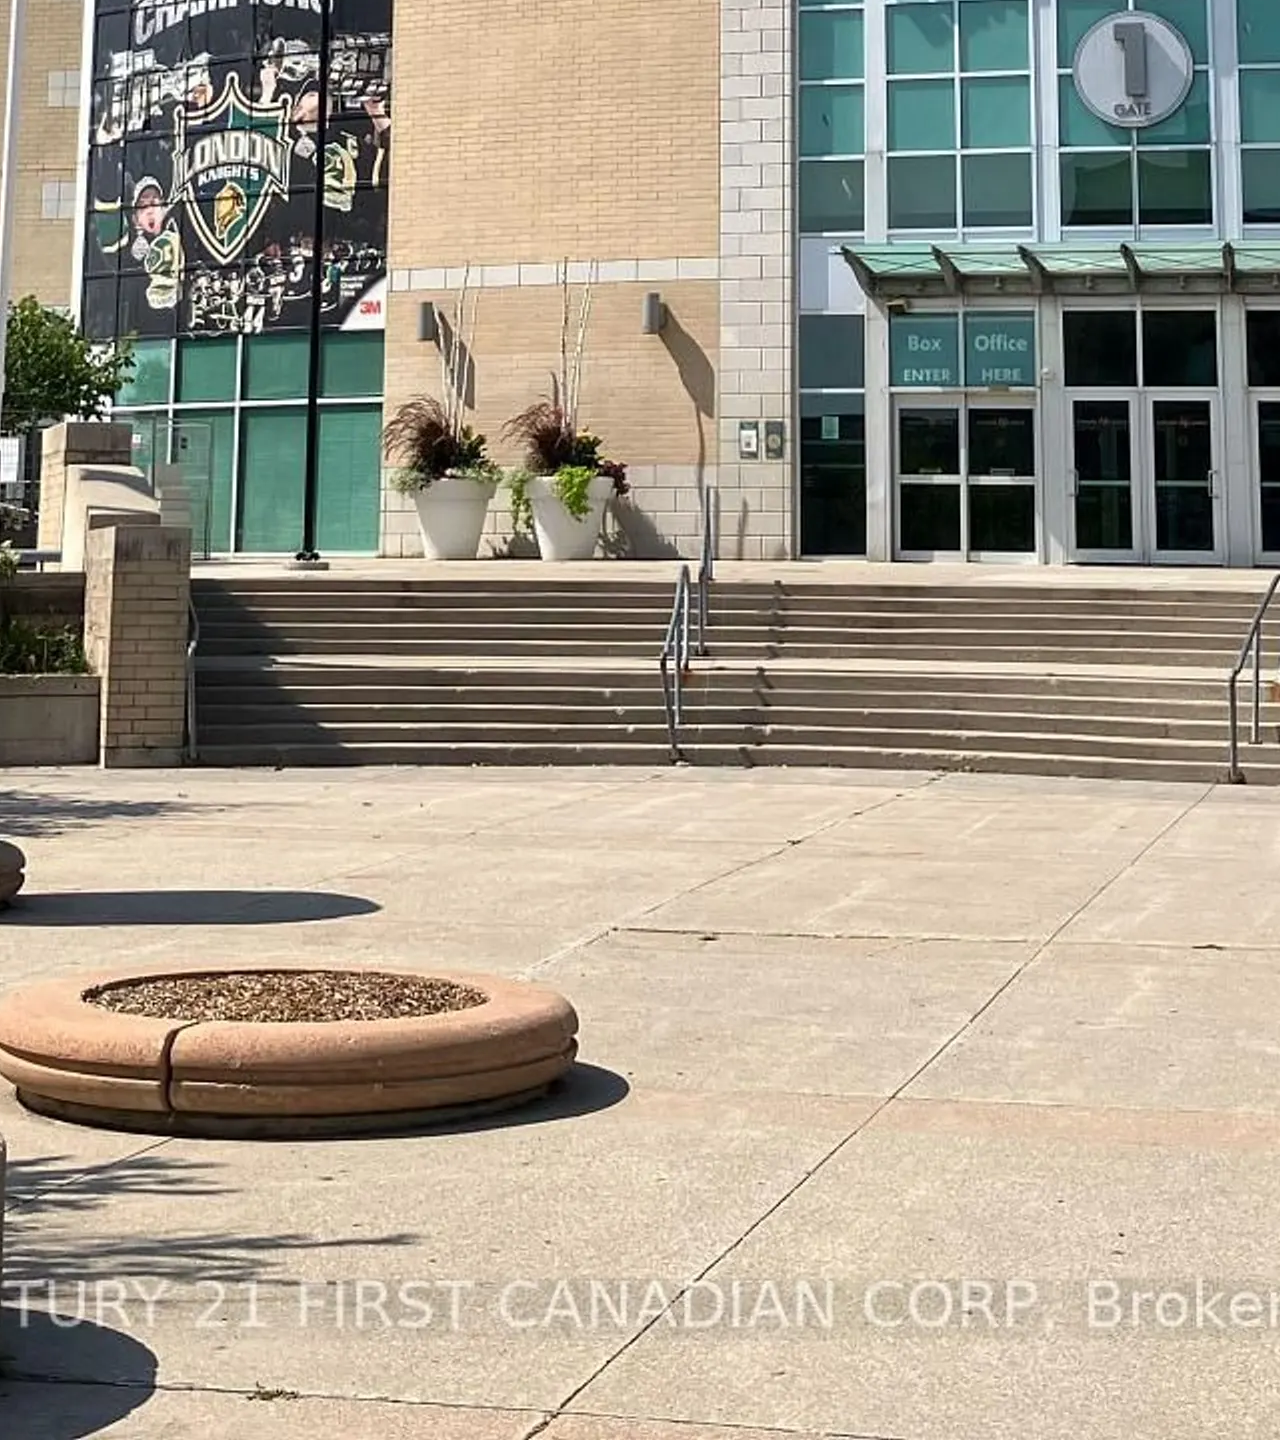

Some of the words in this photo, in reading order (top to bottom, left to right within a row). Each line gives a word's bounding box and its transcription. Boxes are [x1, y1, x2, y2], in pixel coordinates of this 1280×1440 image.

[1113, 22, 1148, 98] 1
[1114, 102, 1152, 118] GATE
[183, 129, 282, 184] LONDON
[197, 165, 260, 187] KNIGHTS
[360, 300, 381, 315] 3M
[907, 334, 943, 352] Box
[974, 333, 1029, 352] Office
[903, 367, 951, 382] ENTER
[981, 367, 1024, 383] HERE
